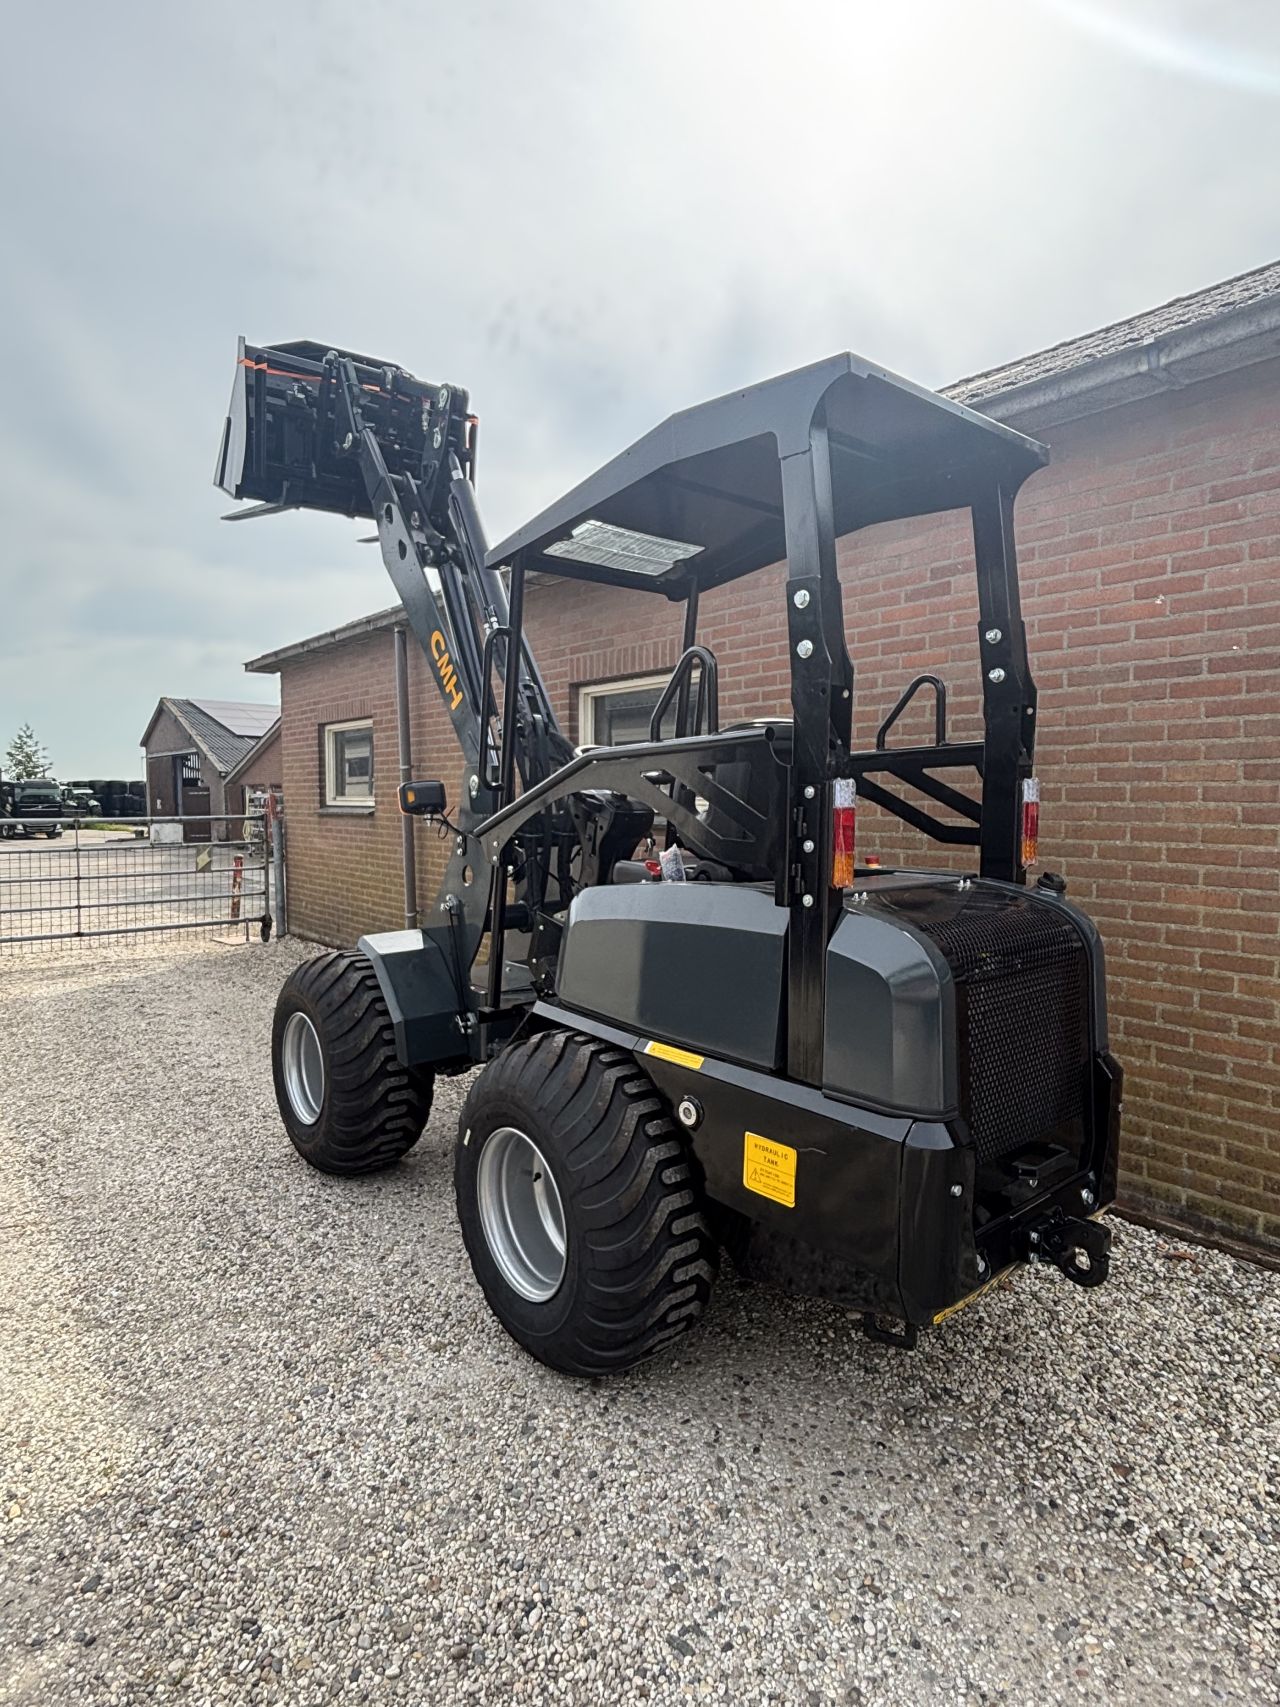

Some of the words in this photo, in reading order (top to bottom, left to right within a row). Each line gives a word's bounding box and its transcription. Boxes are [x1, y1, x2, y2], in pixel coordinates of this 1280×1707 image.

[431, 630, 463, 710] CMH
[754, 1142, 789, 1160] HYDRAULIC
[763, 1155, 779, 1167] TANK
